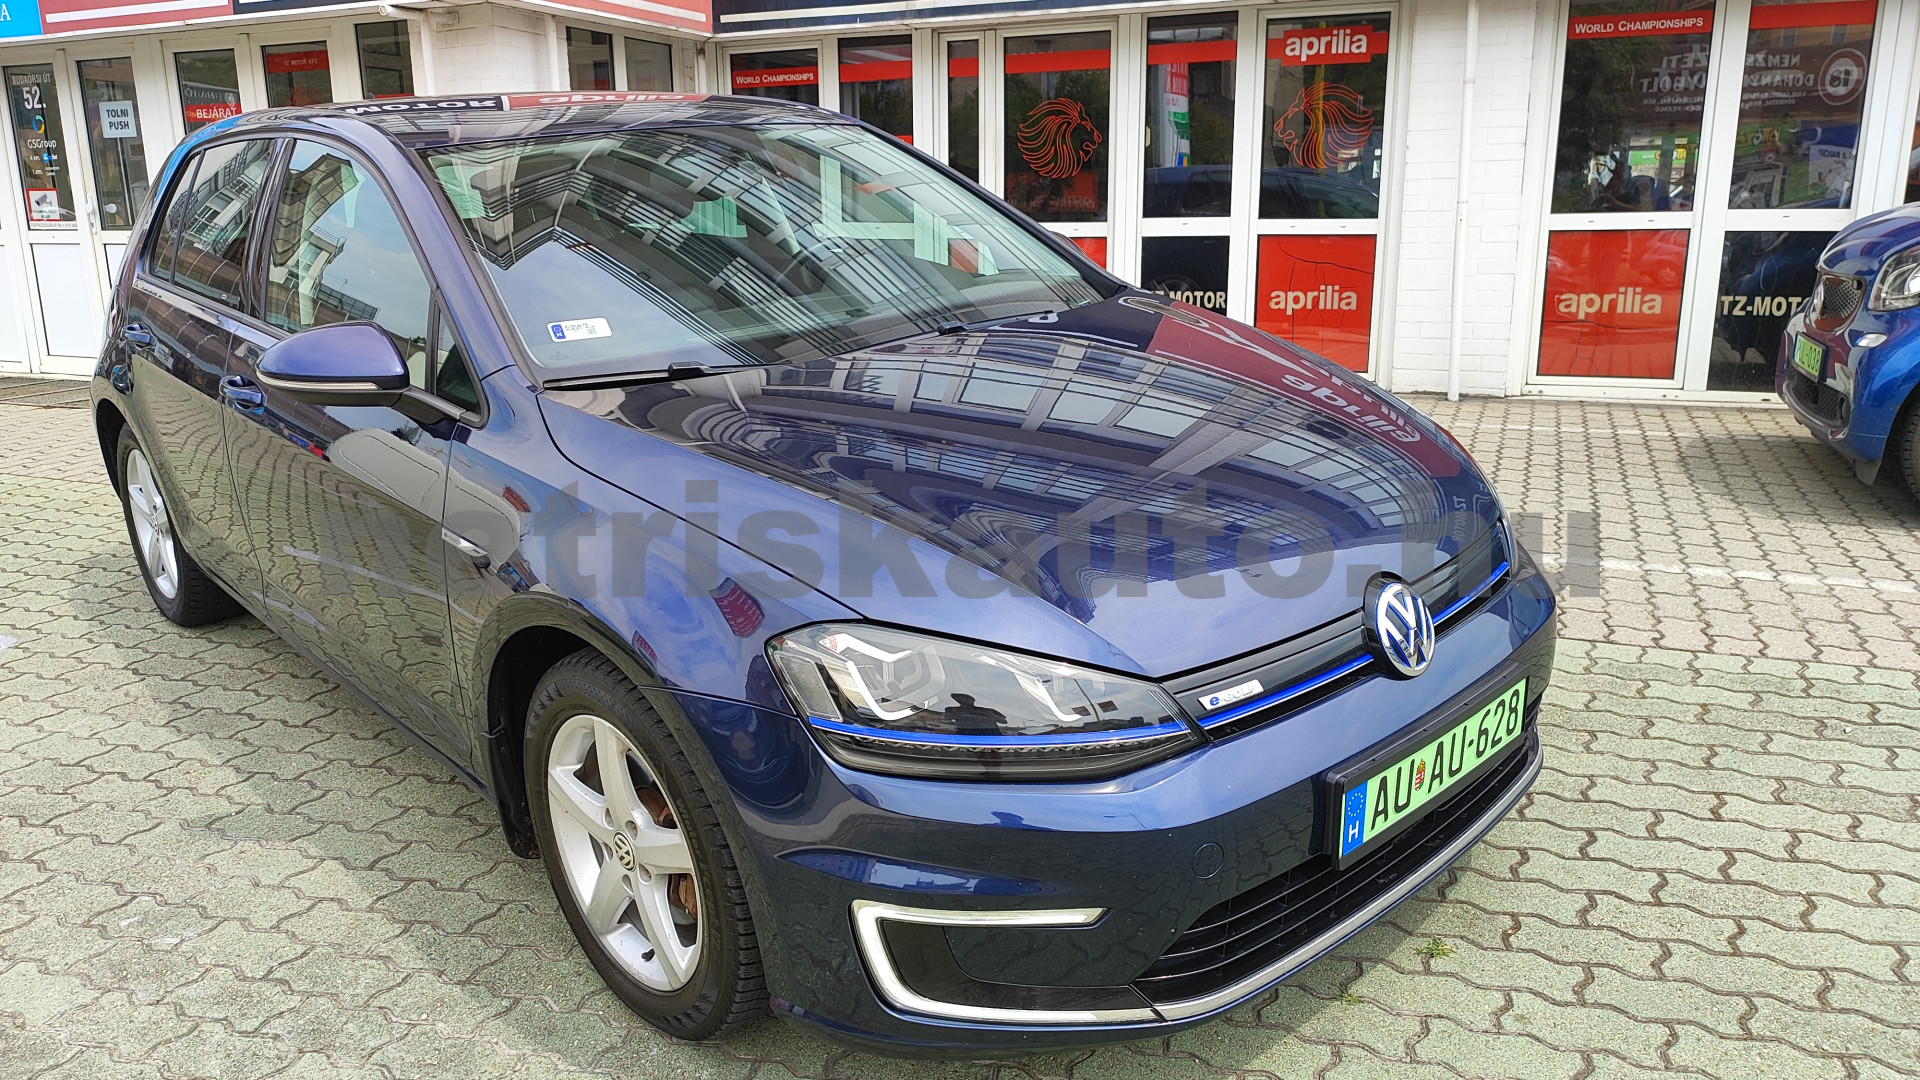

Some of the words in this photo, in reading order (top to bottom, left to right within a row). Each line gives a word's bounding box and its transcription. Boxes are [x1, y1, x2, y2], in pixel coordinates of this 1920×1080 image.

[1574, 21, 1615, 35] WORLD
[1618, 16, 1704, 33] CHAMPIONSHIPS
[1285, 29, 1368, 62] aprilia
[736, 74, 761, 85] WORLD
[762, 71, 815, 84] CHAMPIONSHIPS
[22, 86, 47, 110] 52.
[106, 108, 129, 118] TOLNI
[196, 105, 237, 119] BEJÁRAT
[109, 121, 130, 131] PUSH
[27, 139, 57, 150] GSGroup
[1269, 285, 1358, 315] aprilia
[1558, 287, 1663, 320] aprilia
[1370, 760, 1415, 832] AU
[1427, 688, 1521, 796] AU-628
[1347, 824, 1361, 844] H
